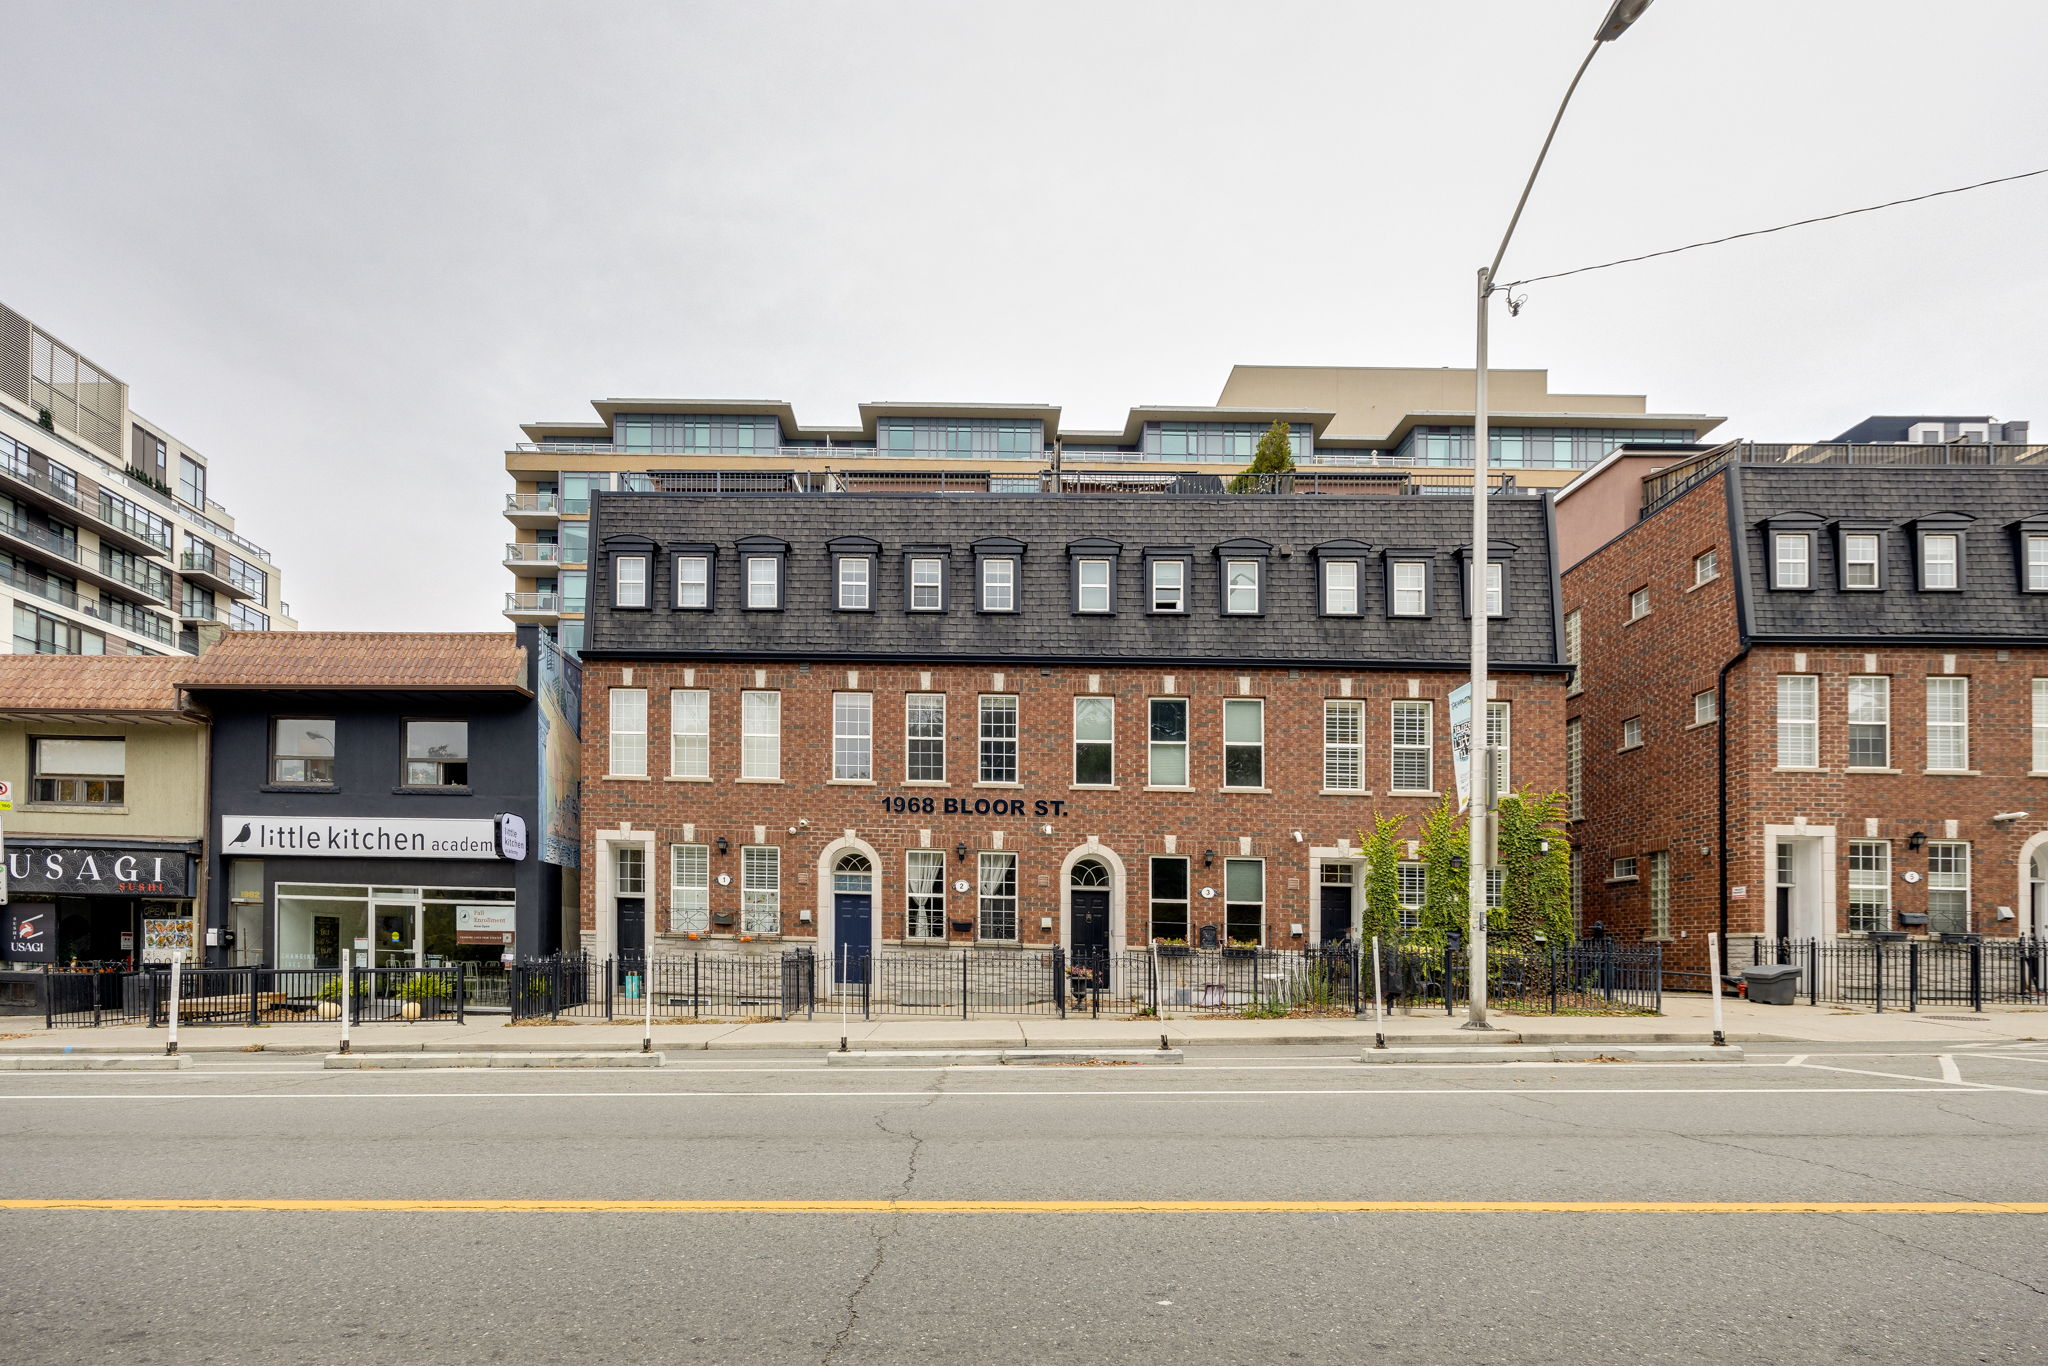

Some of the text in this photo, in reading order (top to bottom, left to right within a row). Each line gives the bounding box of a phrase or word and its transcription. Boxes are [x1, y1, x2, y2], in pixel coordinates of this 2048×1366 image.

[882, 796, 1068, 816] 1968 BLOOR ST.
[261, 825, 494, 852] little kitchen academ
[504, 836, 525, 850] kitchen
[9, 853, 163, 882] USAGI
[118, 882, 164, 893] SUSHI
[959, 882, 964, 890] 2
[11, 942, 44, 952] USAGI
